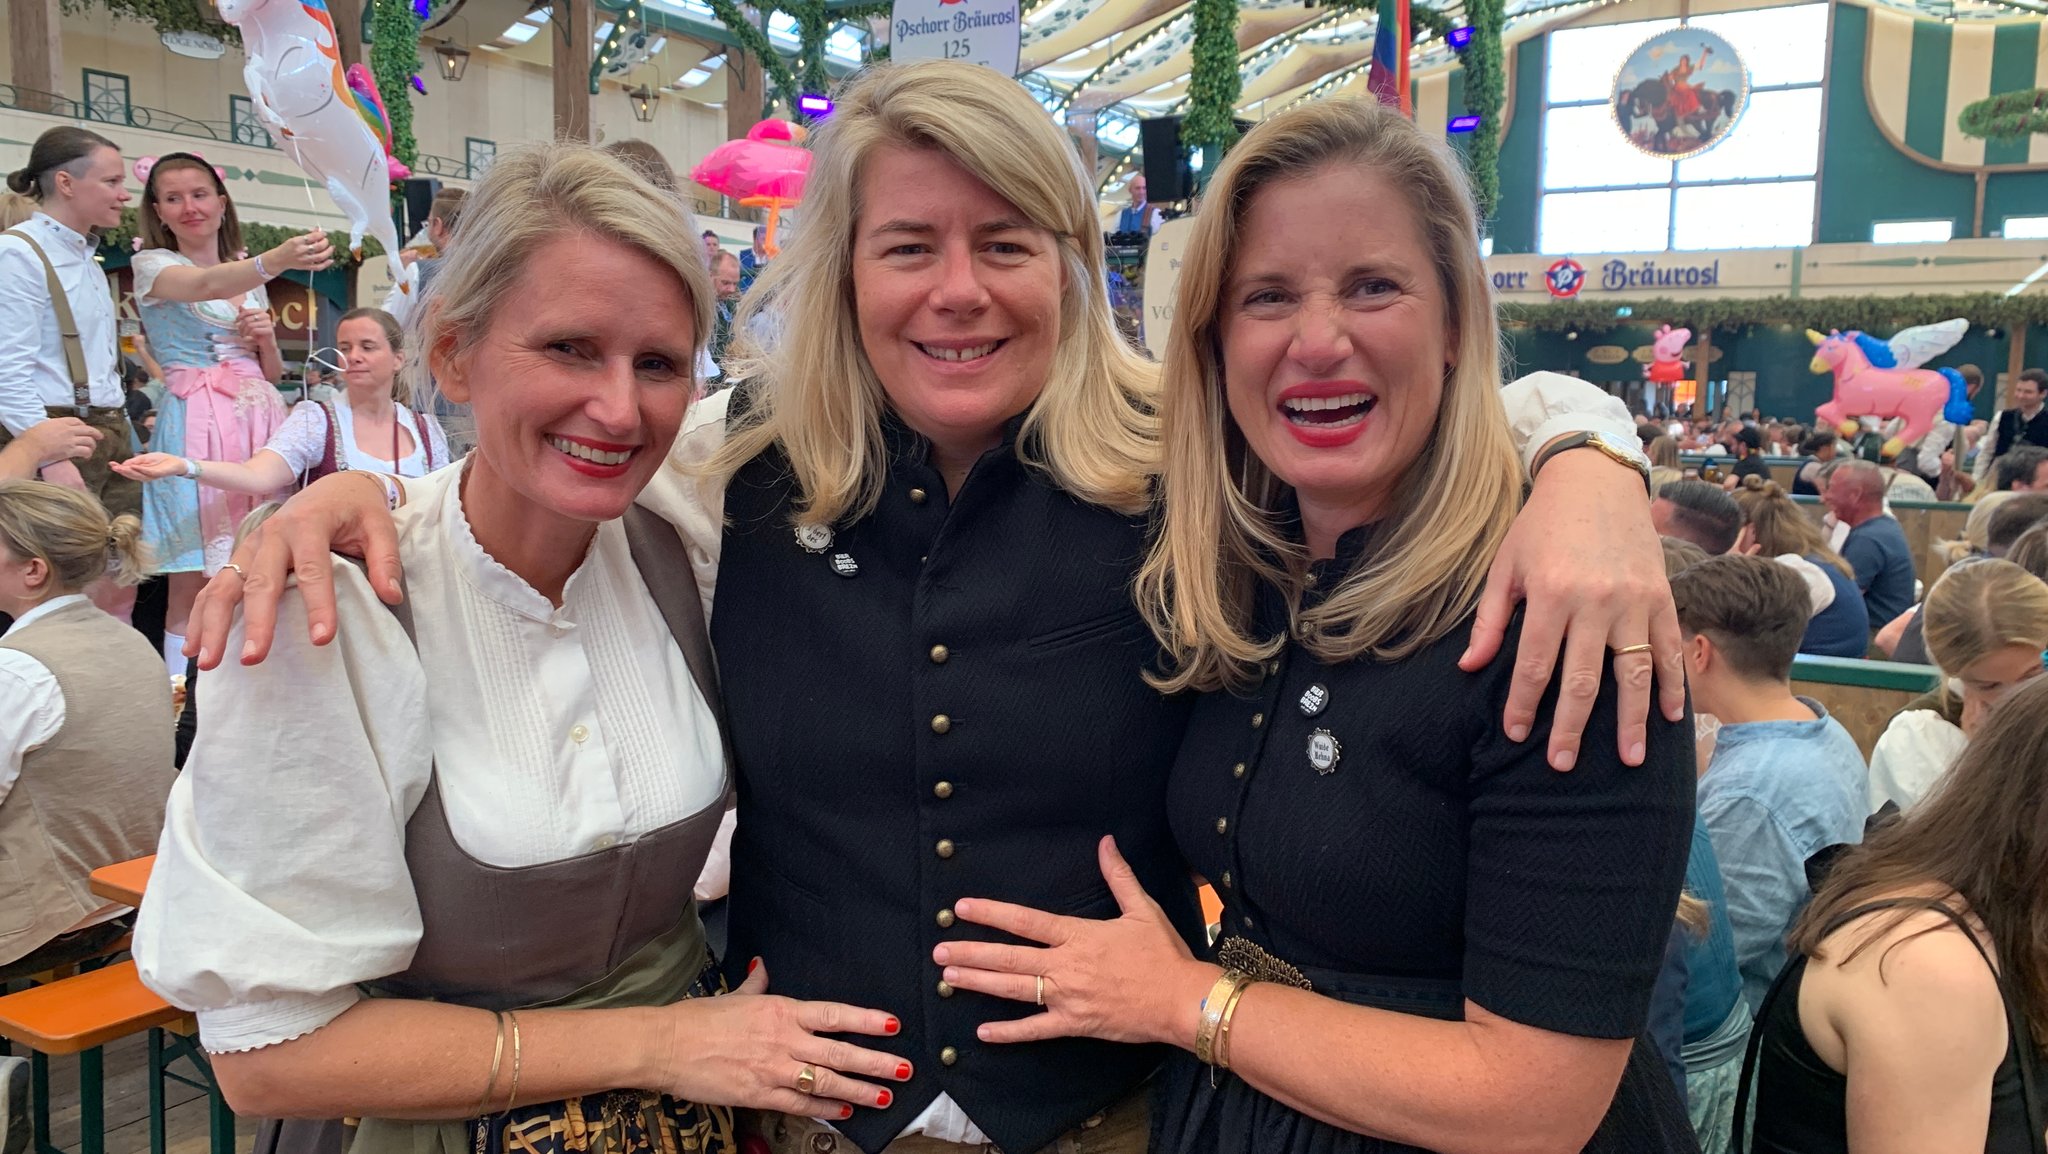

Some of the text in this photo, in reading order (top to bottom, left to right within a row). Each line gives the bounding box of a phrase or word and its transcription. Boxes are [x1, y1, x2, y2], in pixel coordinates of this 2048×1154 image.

[896, 6, 1015, 42] Pschorr Bräurosl
[943, 38, 970, 58] 125
[1603, 259, 1719, 291] Bräurosl
